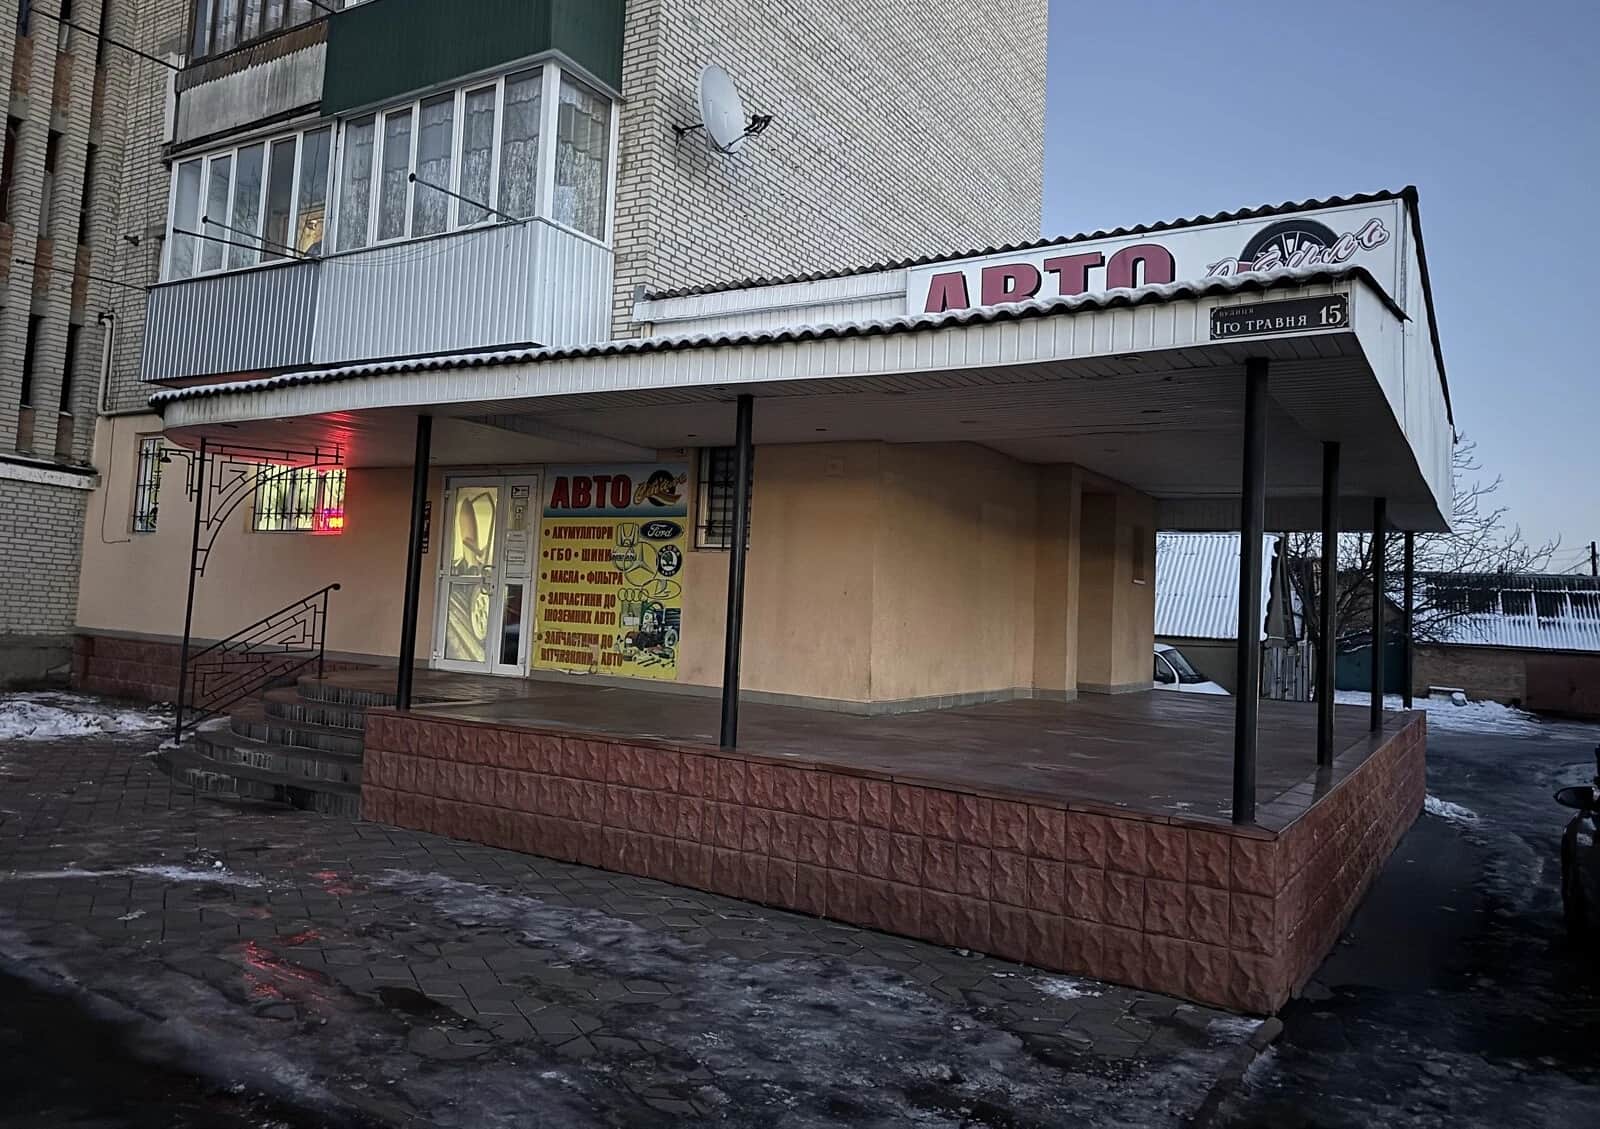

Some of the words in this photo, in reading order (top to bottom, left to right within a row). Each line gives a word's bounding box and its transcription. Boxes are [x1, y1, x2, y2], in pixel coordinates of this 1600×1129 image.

[924, 244, 1177, 313] АВТО
[1246, 315, 1307, 331] ТРАВНЯ
[1319, 304, 1342, 325] 15
[550, 474, 632, 509] АВТО
[552, 526, 614, 540] АКУМУЛЯТОРИ
[647, 523, 673, 537] Ford
[550, 548, 572, 561] ГБО
[581, 548, 613, 562] ШИНИ
[550, 570, 579, 584] МАСЛА
[547, 592, 602, 607] ЗАПЧАСТИНИ
[603, 594, 616, 609] ДО
[544, 609, 592, 624] ІНОЗЕМНИХ
[594, 611, 616, 625] АВТО
[544, 631, 599, 648] ЗАПЧАСТИНИ
[600, 635, 613, 649] ДО
[601, 651, 623, 666] АВТО
